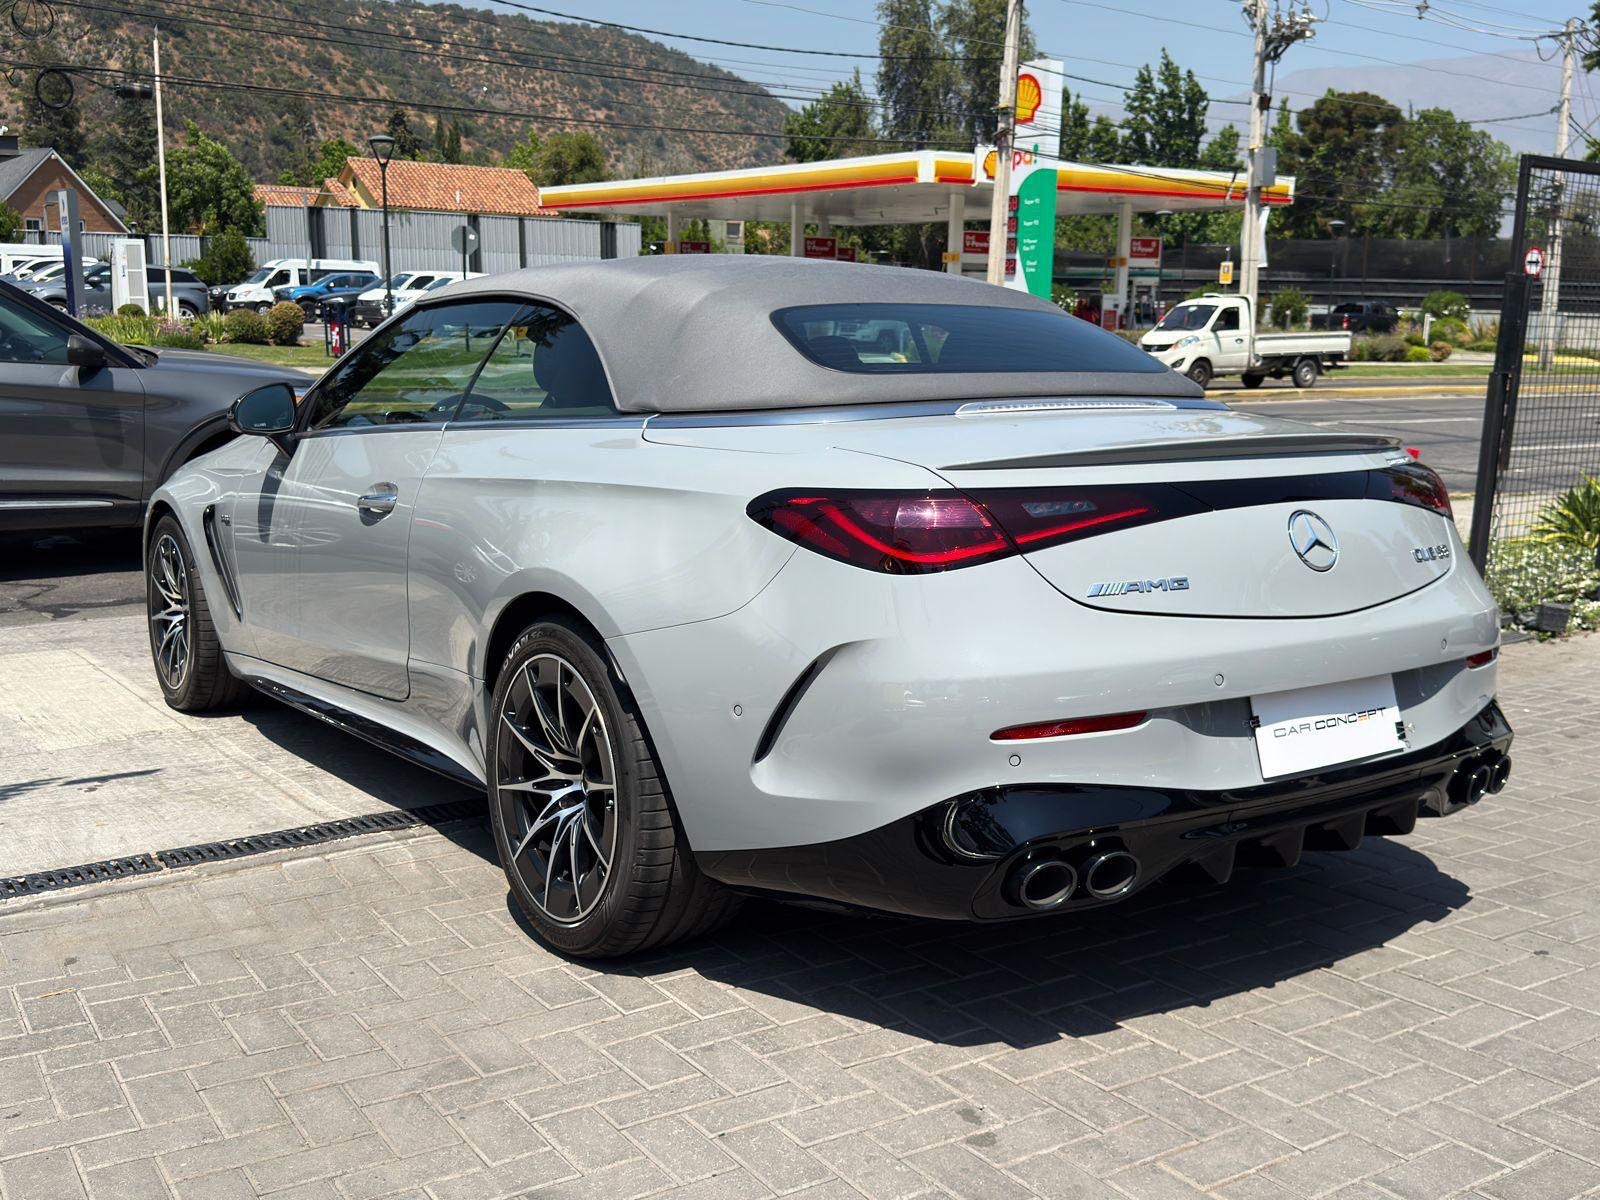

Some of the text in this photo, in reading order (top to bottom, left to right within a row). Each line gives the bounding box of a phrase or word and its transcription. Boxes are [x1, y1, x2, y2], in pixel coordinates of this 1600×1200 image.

[1012, 143, 1039, 171] pa!
[1121, 576, 1190, 595] AMG
[502, 633, 529, 672] DVAN
[1273, 706, 1387, 738] CAR CONCEPT
